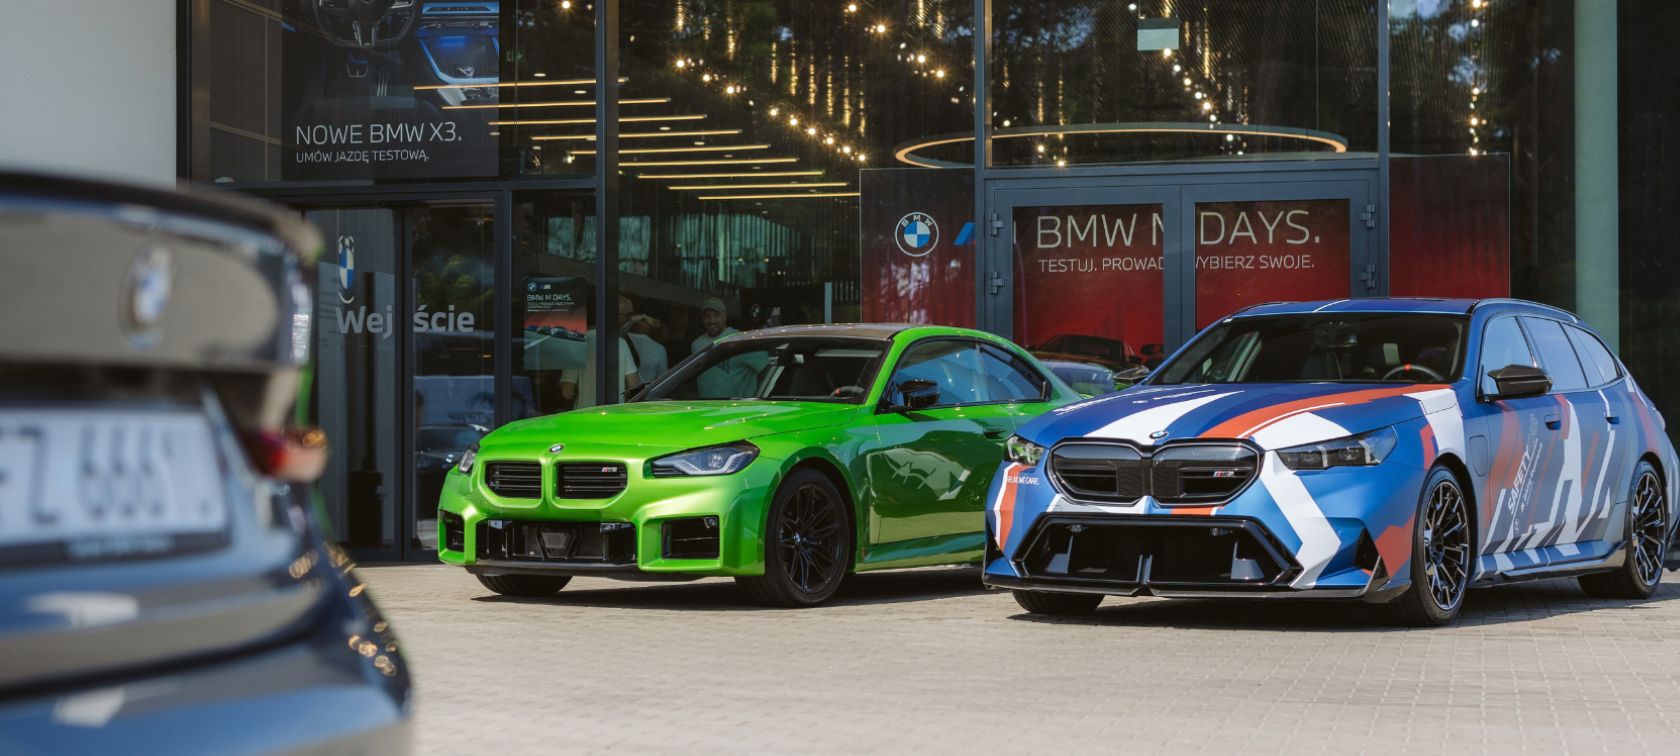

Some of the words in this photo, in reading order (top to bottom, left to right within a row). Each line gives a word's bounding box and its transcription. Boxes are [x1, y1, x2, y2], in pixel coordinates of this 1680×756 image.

[296, 124, 363, 145] NOWE
[370, 123, 425, 144] BMW
[429, 121, 462, 142] X3.
[296, 150, 333, 163] UMÓW
[334, 150, 369, 164] JAZDĘ
[372, 149, 430, 162] TESTOWĄ.
[1036, 212, 1137, 249] BMW
[1199, 209, 1321, 246] DAYS.
[1037, 258, 1098, 273] TESTUJ.
[1102, 256, 1164, 271] PROWAD
[1195, 255, 1255, 270] YBIERZ
[1259, 254, 1315, 269] SWOJE.
[1507, 444, 1531, 516] SAFETY
